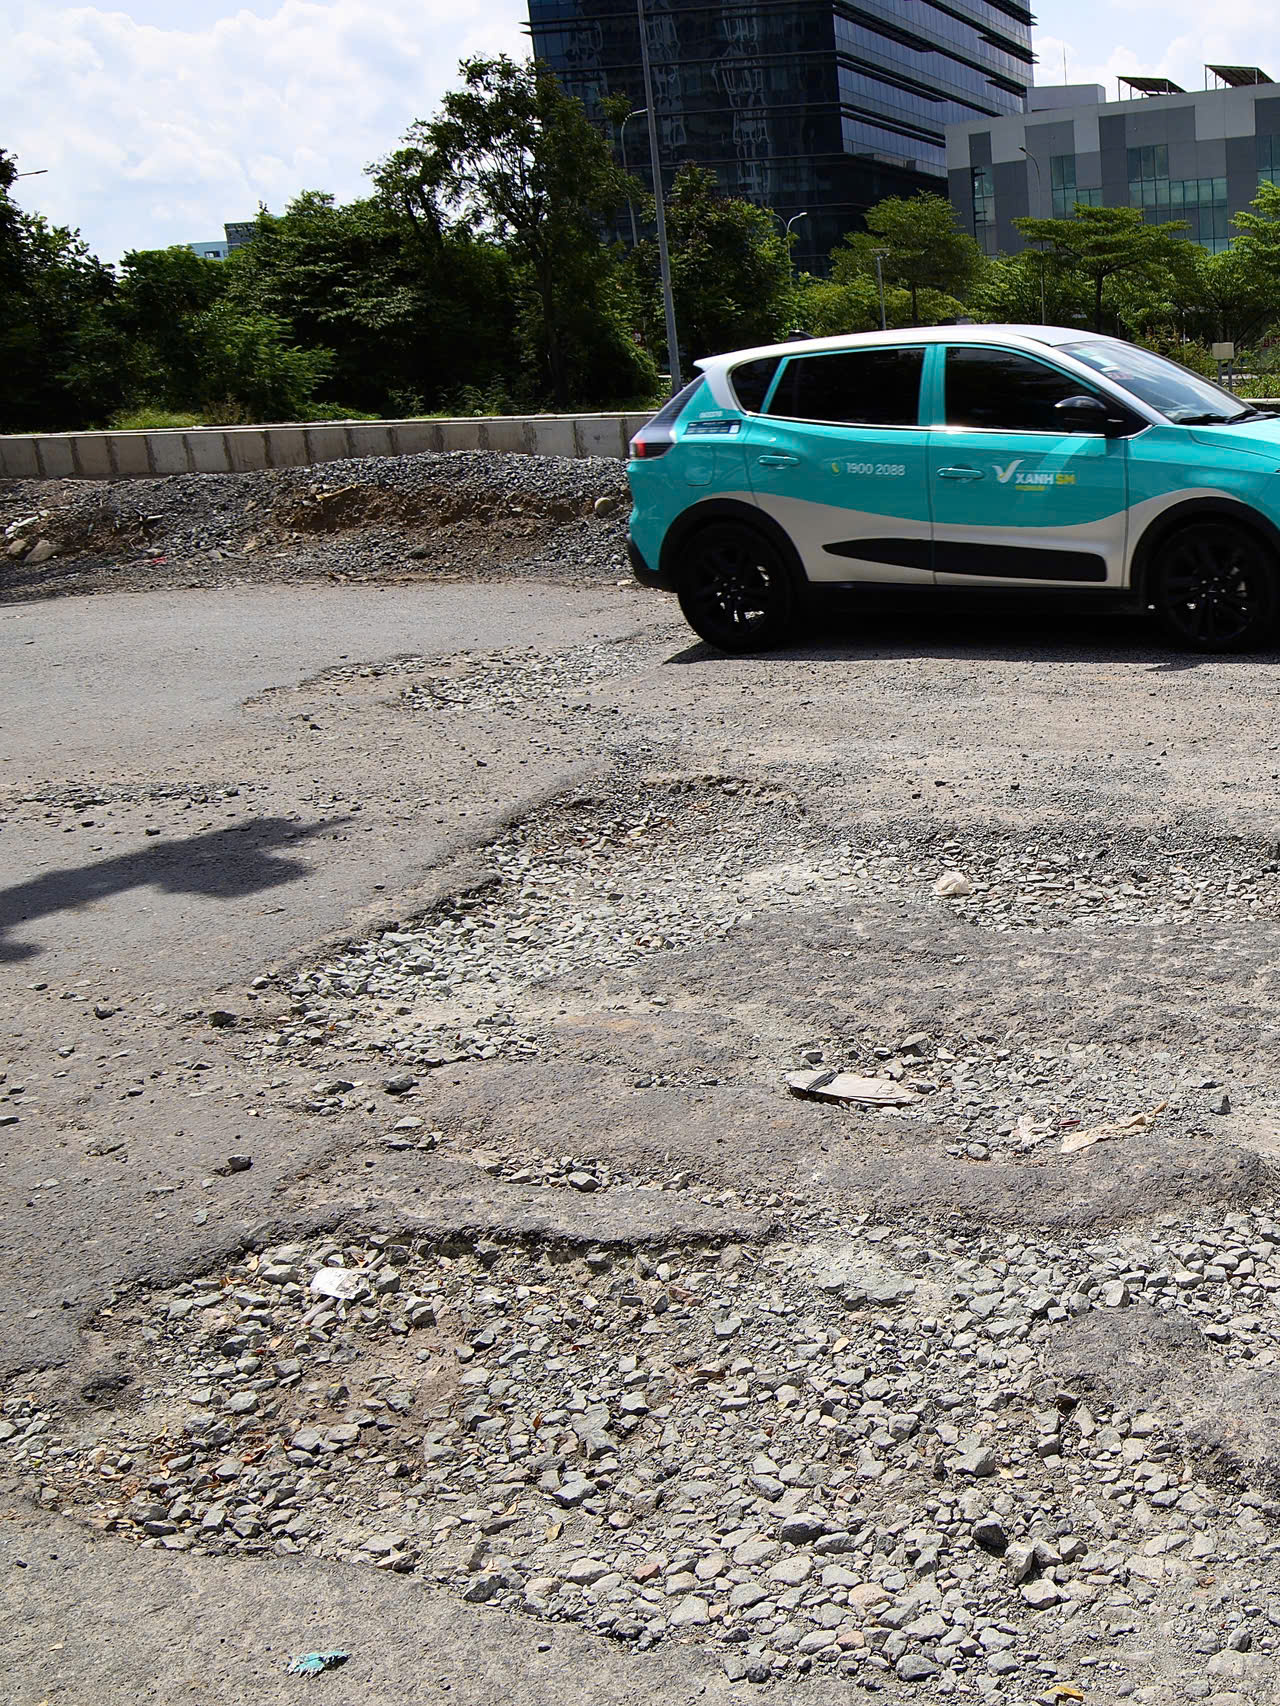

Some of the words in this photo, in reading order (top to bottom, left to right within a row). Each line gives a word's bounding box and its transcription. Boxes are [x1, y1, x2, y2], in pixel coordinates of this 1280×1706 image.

[846, 463, 874, 474] 1900
[875, 464, 905, 476] 2088
[1015, 473, 1054, 485] XANH
